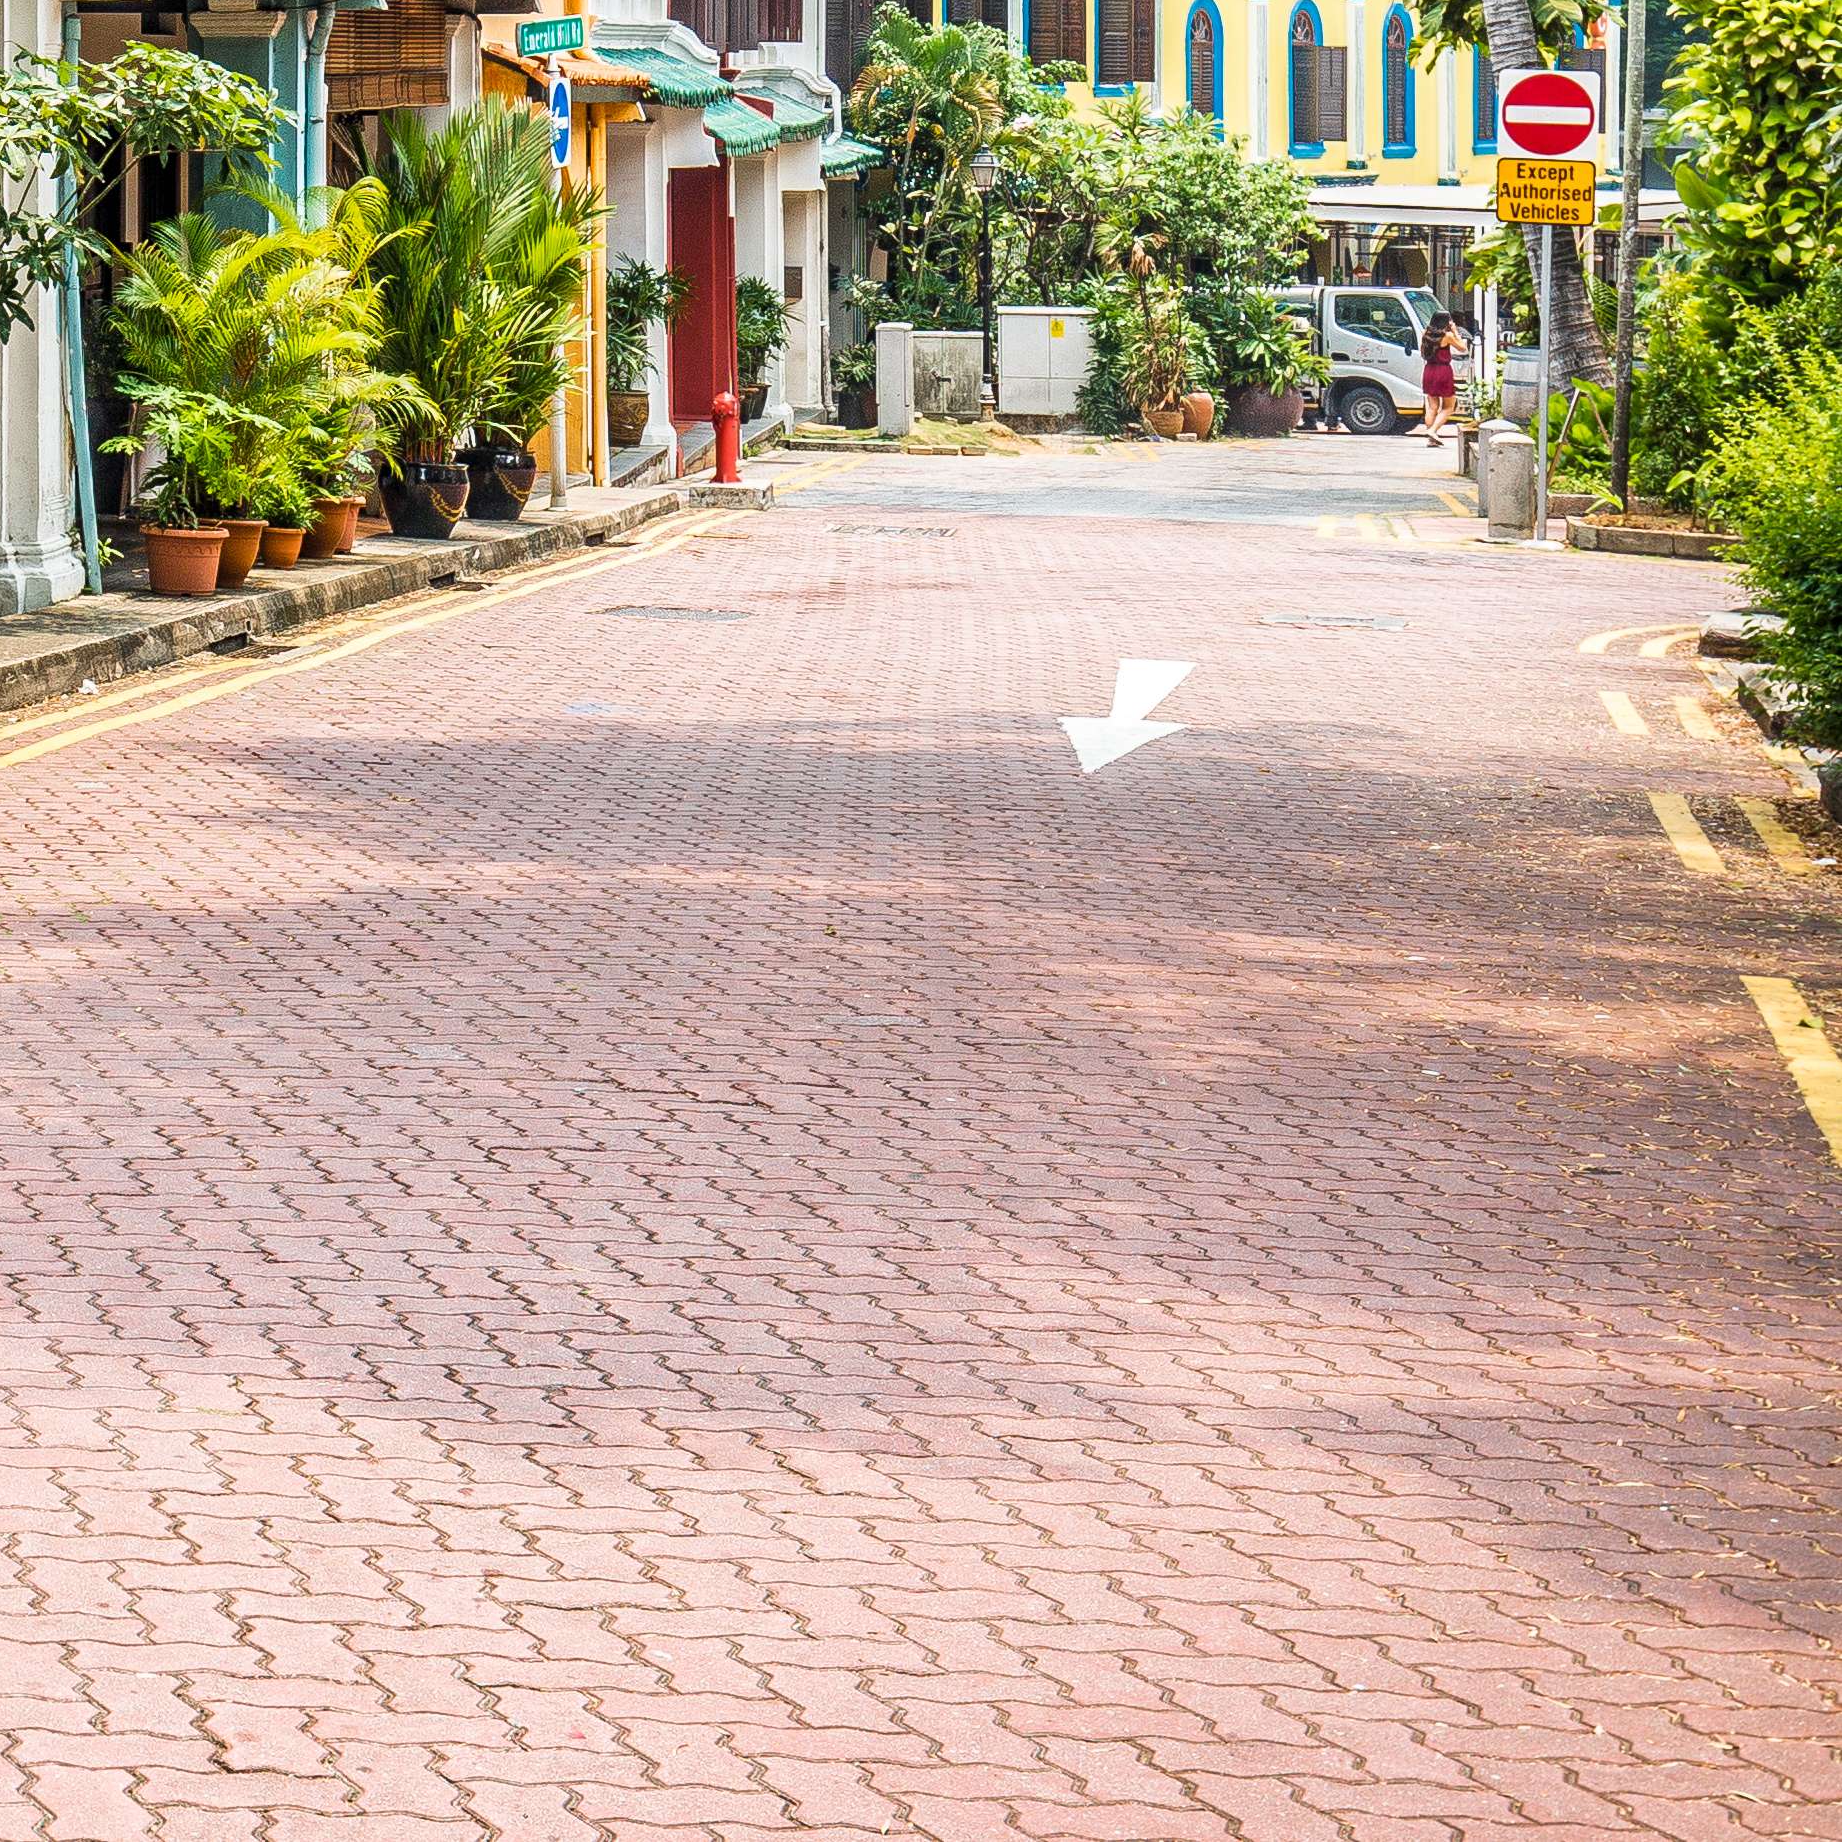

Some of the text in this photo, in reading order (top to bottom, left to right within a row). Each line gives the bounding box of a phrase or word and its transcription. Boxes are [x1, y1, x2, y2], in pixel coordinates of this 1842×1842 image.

[524, 21, 581, 51] Emerald Hill Rd
[1517, 163, 1574, 183] Except
[1500, 183, 1592, 201] Authorised
[1510, 202, 1579, 221] Vehicles
